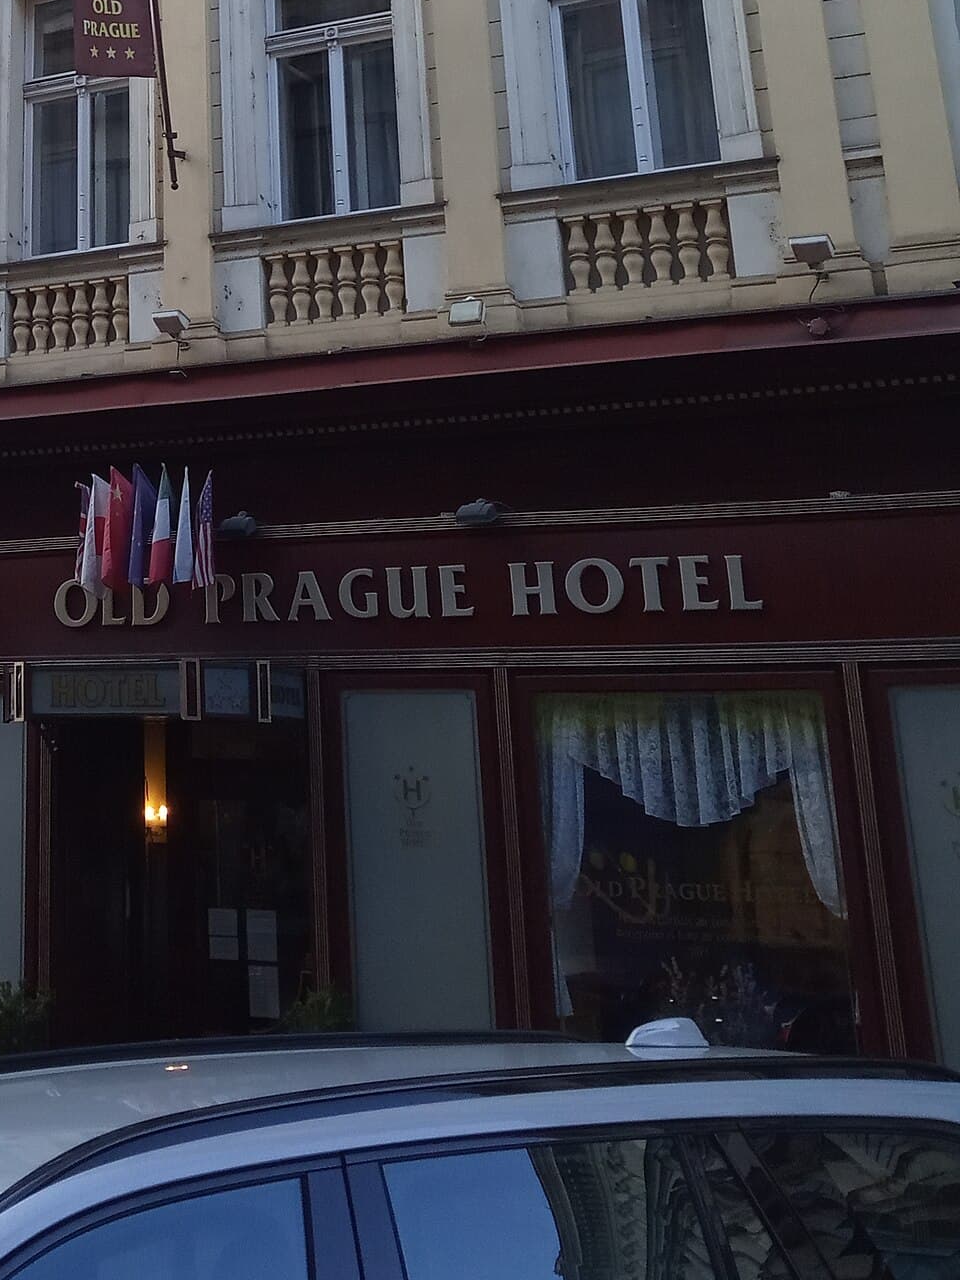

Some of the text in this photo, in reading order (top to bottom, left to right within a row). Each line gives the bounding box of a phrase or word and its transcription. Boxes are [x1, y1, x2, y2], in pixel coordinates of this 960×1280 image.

[83, 19, 141, 38] PRAGUE
[53, 554, 765, 628] OLD PRAGUE HOTEL
[50, 672, 167, 708] HOTEL
